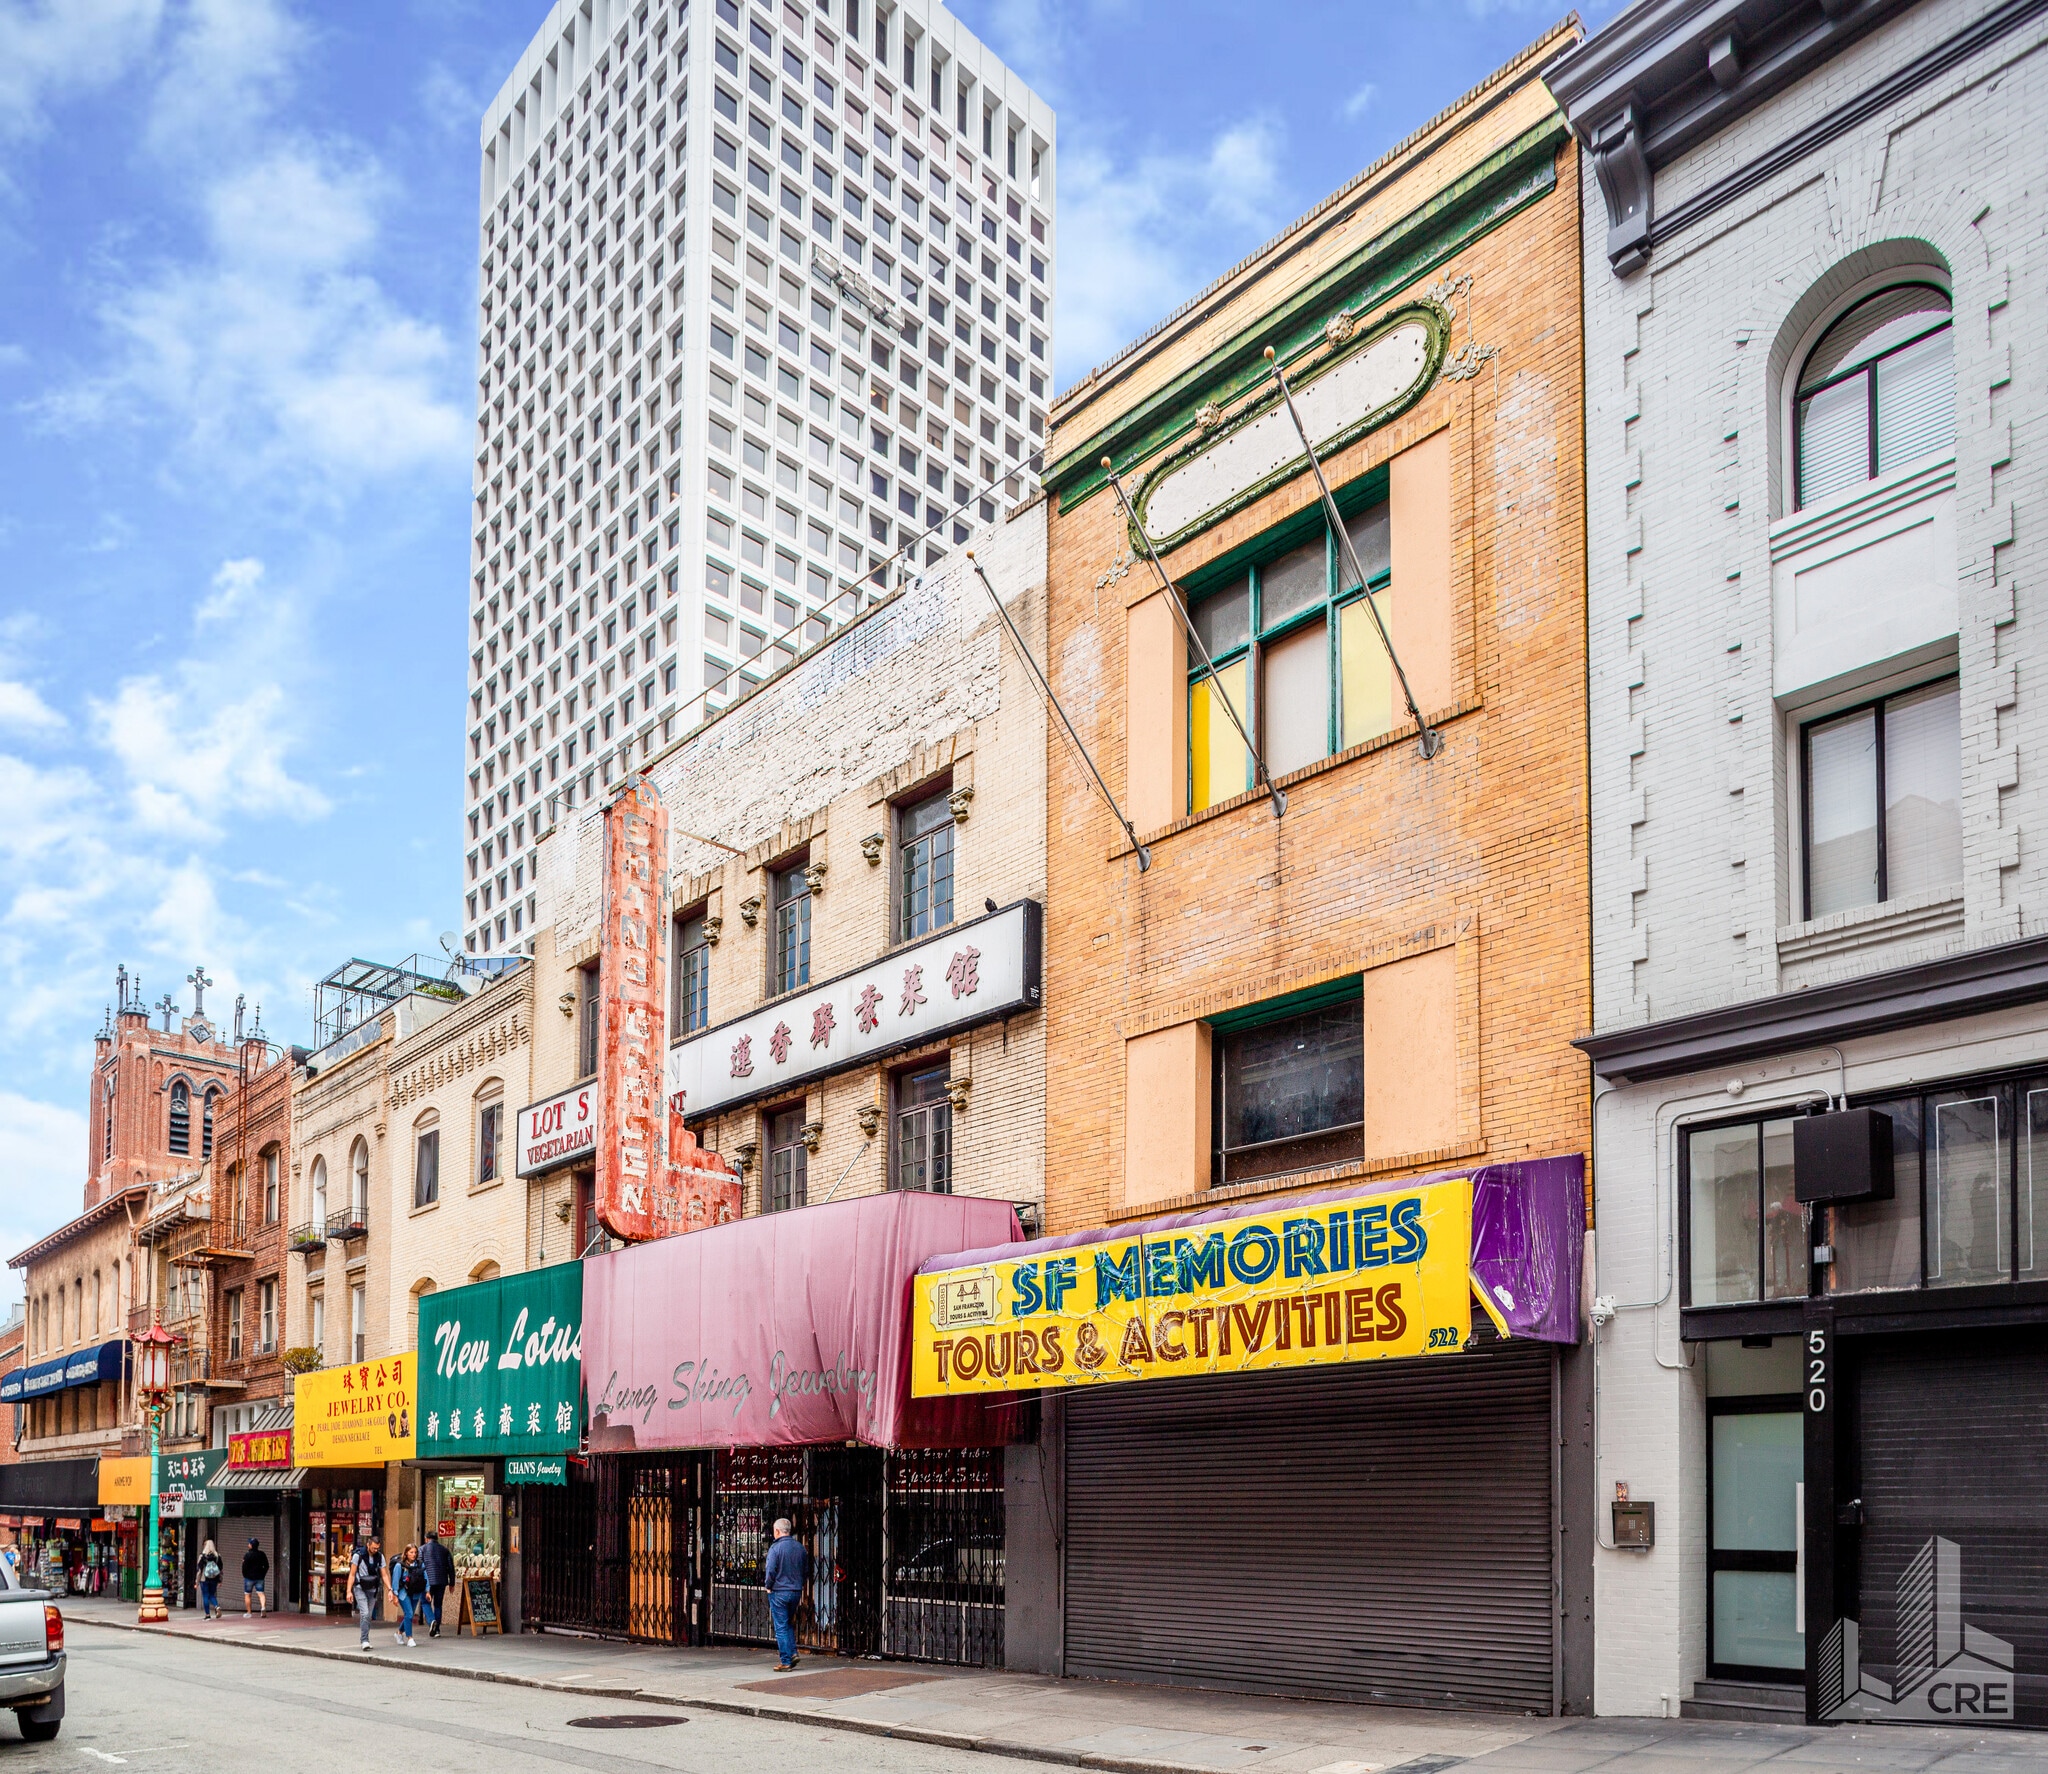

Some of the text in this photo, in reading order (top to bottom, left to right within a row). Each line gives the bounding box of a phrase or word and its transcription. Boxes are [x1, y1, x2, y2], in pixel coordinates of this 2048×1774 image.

[531, 1101, 566, 1139] LOT
[527, 1124, 594, 1166] VEGETARIAN
[1011, 1198, 1428, 1317] SF MEMORIES
[934, 1283, 1407, 1383] TOURS & ACTIVITIES
[950, 1312, 963, 1320] TOURS
[434, 1320, 490, 1379] New
[1428, 1326, 1459, 1348] 522
[343, 1360, 402, 1394] 珠寶公司
[594, 1350, 878, 1424] Lung Shing Jewelry
[1808, 1329, 1826, 1412] 520
[326, 1390, 410, 1418] JEWELRY CO.
[427, 1401, 573, 1441] 新蓮香齋菜館
[508, 1461, 562, 1478] CHAN'S Jewelry
